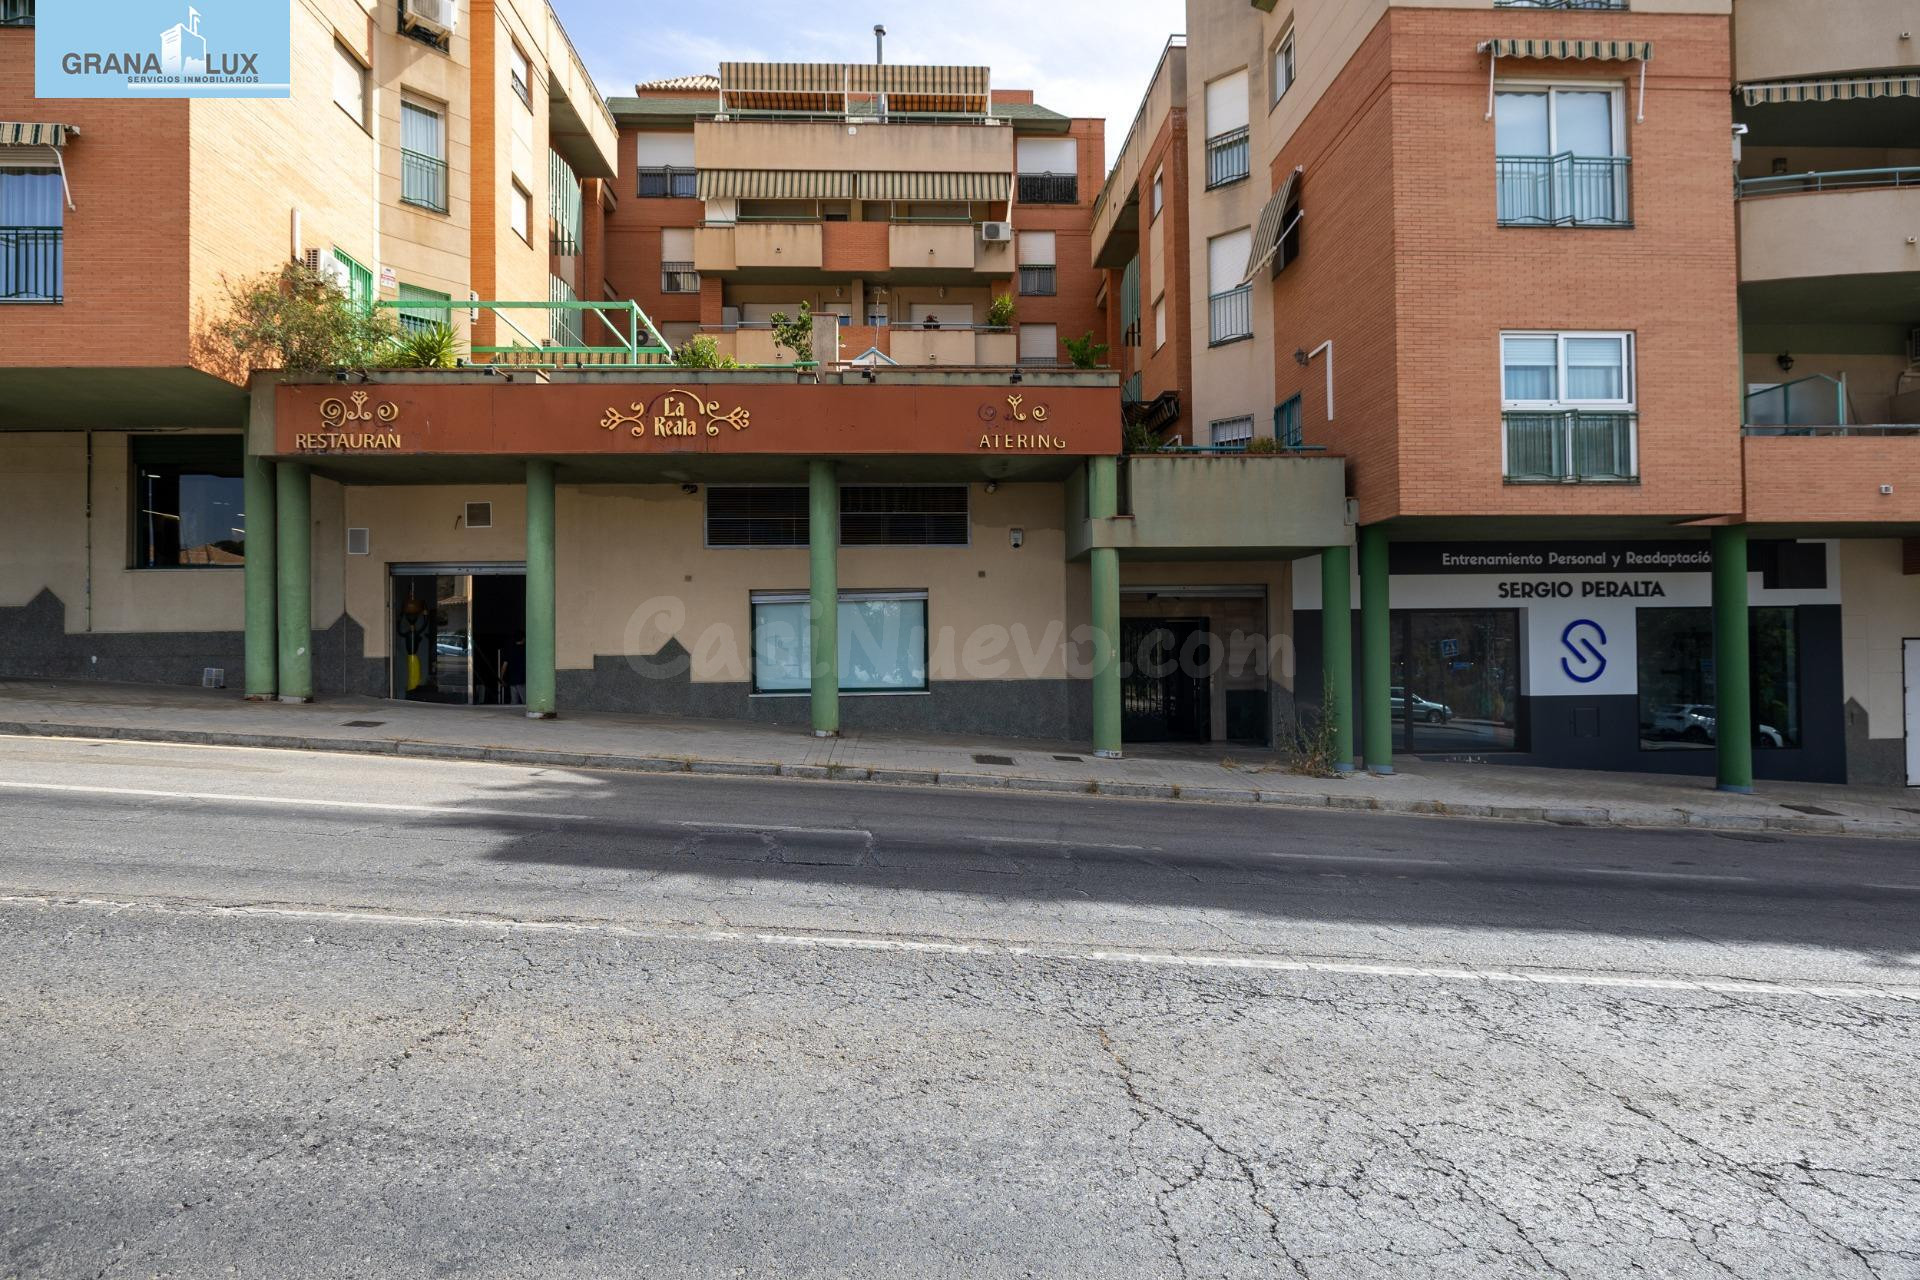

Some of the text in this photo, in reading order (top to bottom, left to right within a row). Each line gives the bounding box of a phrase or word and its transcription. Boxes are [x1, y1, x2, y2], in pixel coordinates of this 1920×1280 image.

[664, 397, 685, 417] La
[654, 417, 697, 438] Reala
[295, 433, 401, 448] RESTAURAN
[979, 434, 1066, 449] ATERING
[1442, 551, 1713, 568] Entrenamiento Personal y Readaptació
[1498, 581, 1666, 598] SERGIO PERALTA
